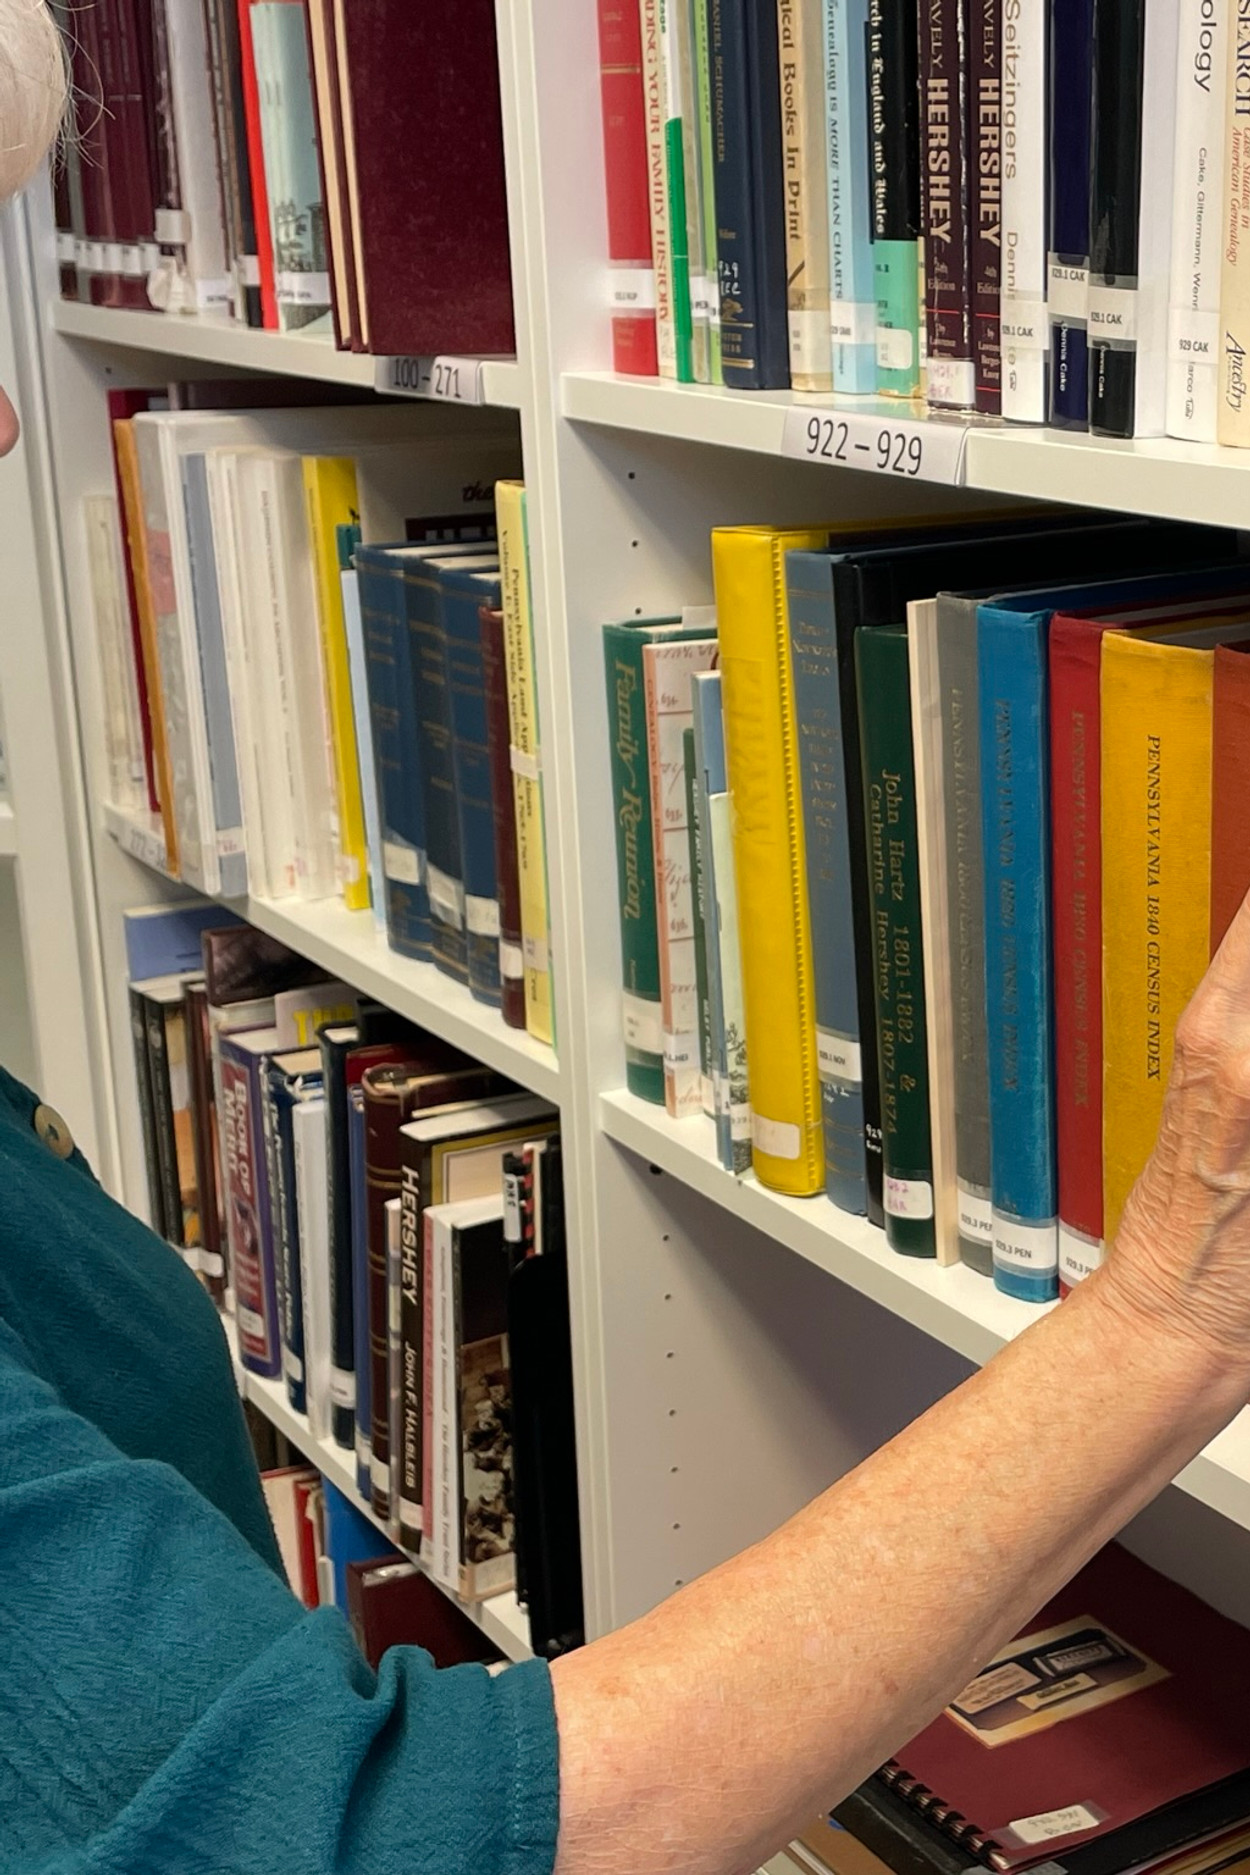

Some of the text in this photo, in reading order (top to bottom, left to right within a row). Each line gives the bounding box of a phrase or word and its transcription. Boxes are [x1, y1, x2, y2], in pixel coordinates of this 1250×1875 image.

[871, 57, 886, 134] England
[1003, 0, 1021, 180] Seitzingers
[783, 62, 803, 242] Books In Print
[828, 118, 840, 170] MORE
[874, 141, 886, 174] and
[927, 78, 951, 244] HERSHEY
[979, 78, 1001, 248] HERSHEY
[648, 70, 669, 322] YOUR FAMILY HISTORY
[831, 176, 842, 226] THAN
[874, 178, 888, 234] Wales
[1226, 127, 1243, 267] American Genealogy
[833, 231, 843, 299] CHARTS
[1070, 271, 1086, 282] CAK
[1018, 327, 1033, 338] CAK
[1107, 314, 1123, 325] CAK
[1179, 339, 1209, 353] 929 CAK
[1226, 331, 1248, 412] Ancestry
[615, 659, 638, 789] Family
[869, 783, 885, 895] Catharine
[882, 768, 917, 1092] John Hartz 1801-1882 &
[1146, 734, 1161, 1081] PENNSYLVANIA 1840 CENSUS INDEX
[876, 910, 892, 1001] Hershey
[401, 1165, 420, 1307] HERSHEY
[1014, 1245, 1033, 1259] PEN
[404, 1341, 416, 1388] JOHN
